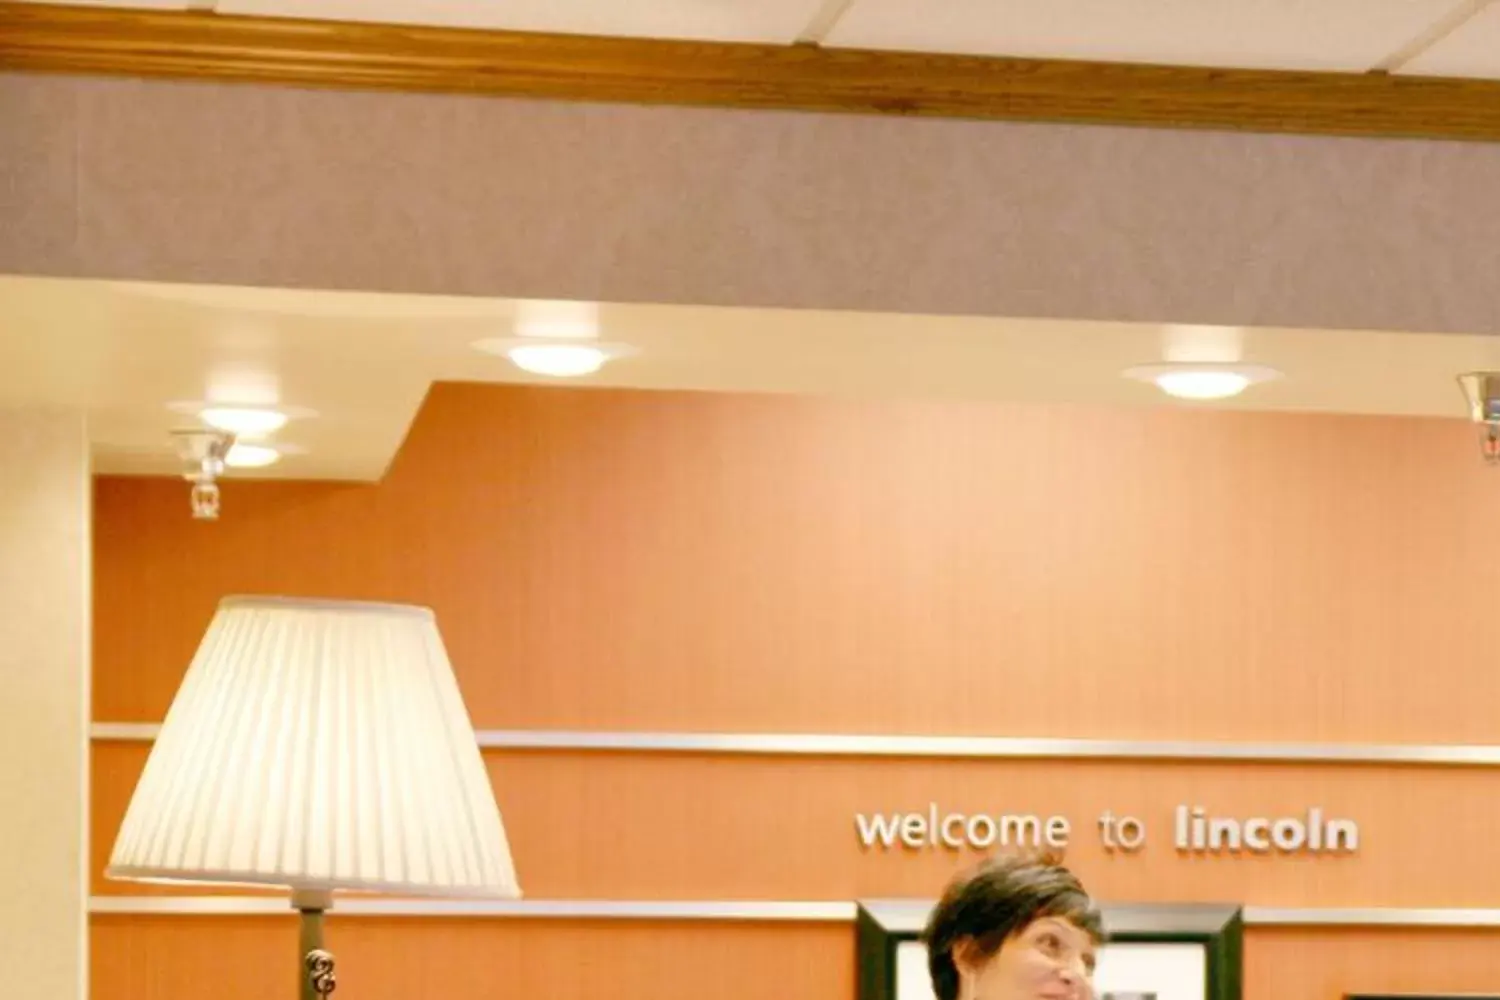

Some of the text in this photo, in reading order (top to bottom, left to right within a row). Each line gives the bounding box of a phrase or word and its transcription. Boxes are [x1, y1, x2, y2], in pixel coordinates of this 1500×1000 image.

[856, 803, 1360, 852] welcome to lincoln
